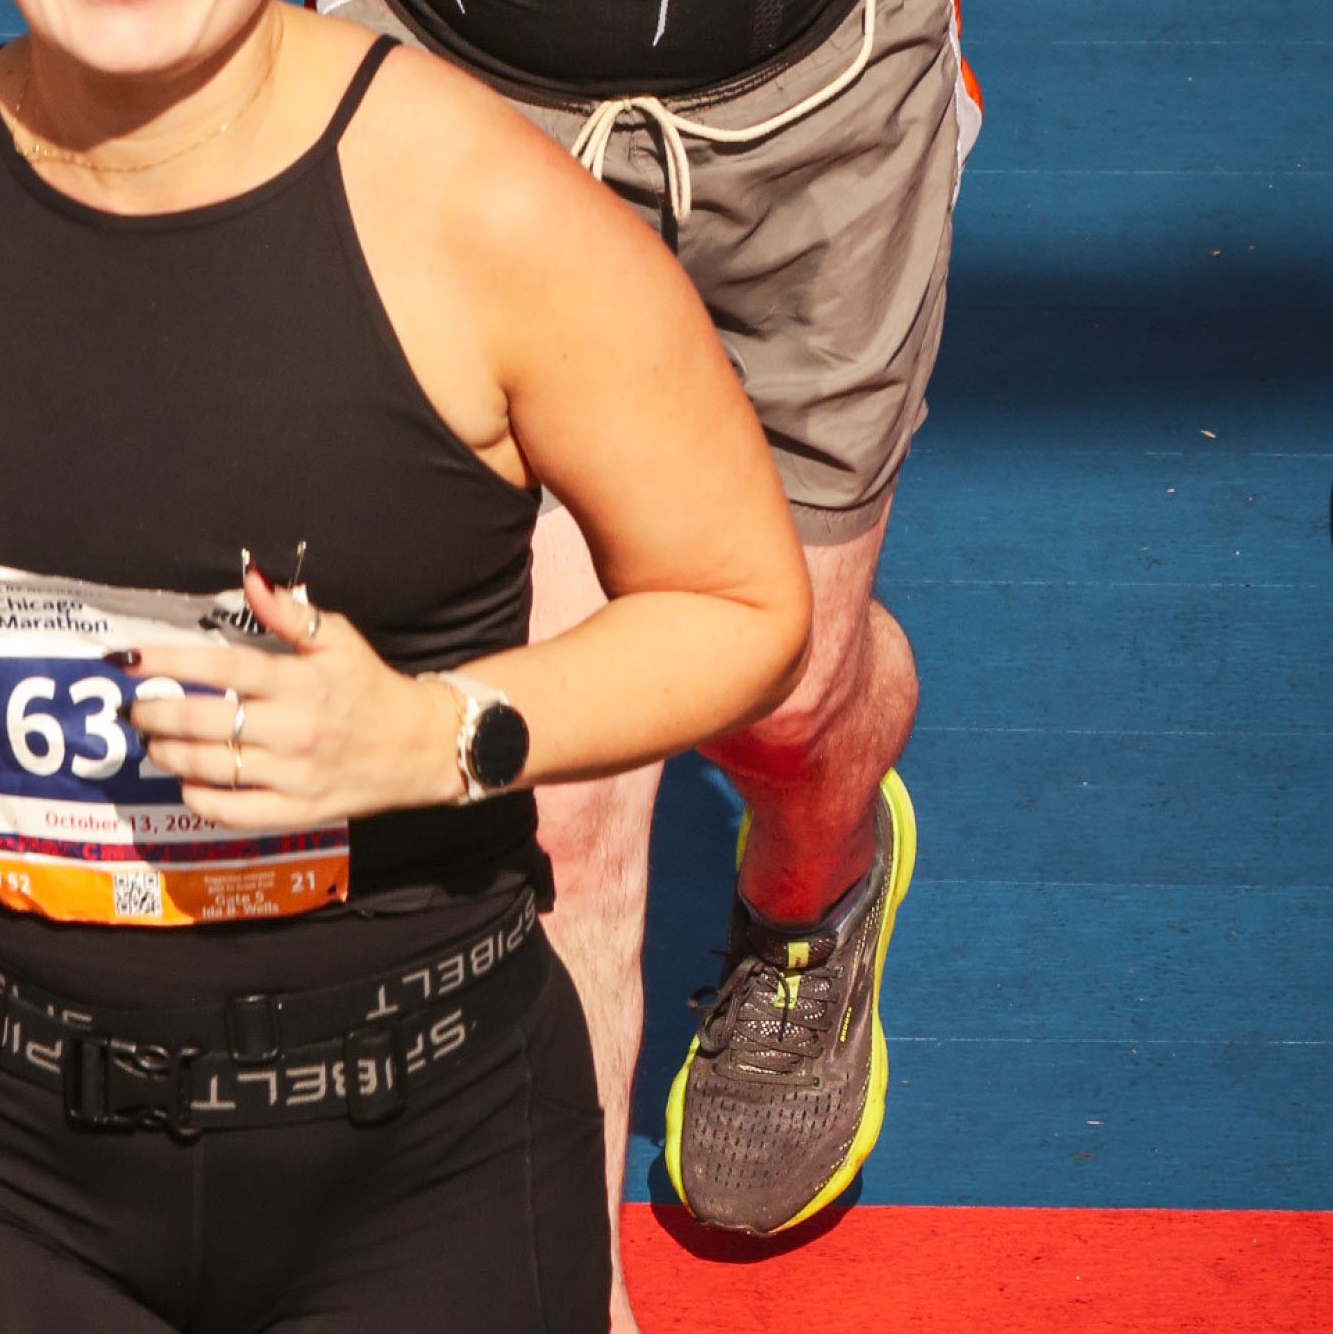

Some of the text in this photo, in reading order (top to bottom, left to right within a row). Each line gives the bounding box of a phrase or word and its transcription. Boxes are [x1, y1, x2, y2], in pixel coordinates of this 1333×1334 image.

[45, 810, 120, 832] October
[130, 815, 159, 836] 13,
[291, 870, 316, 894] 21
[366, 887, 536, 1020] SPIBELT
